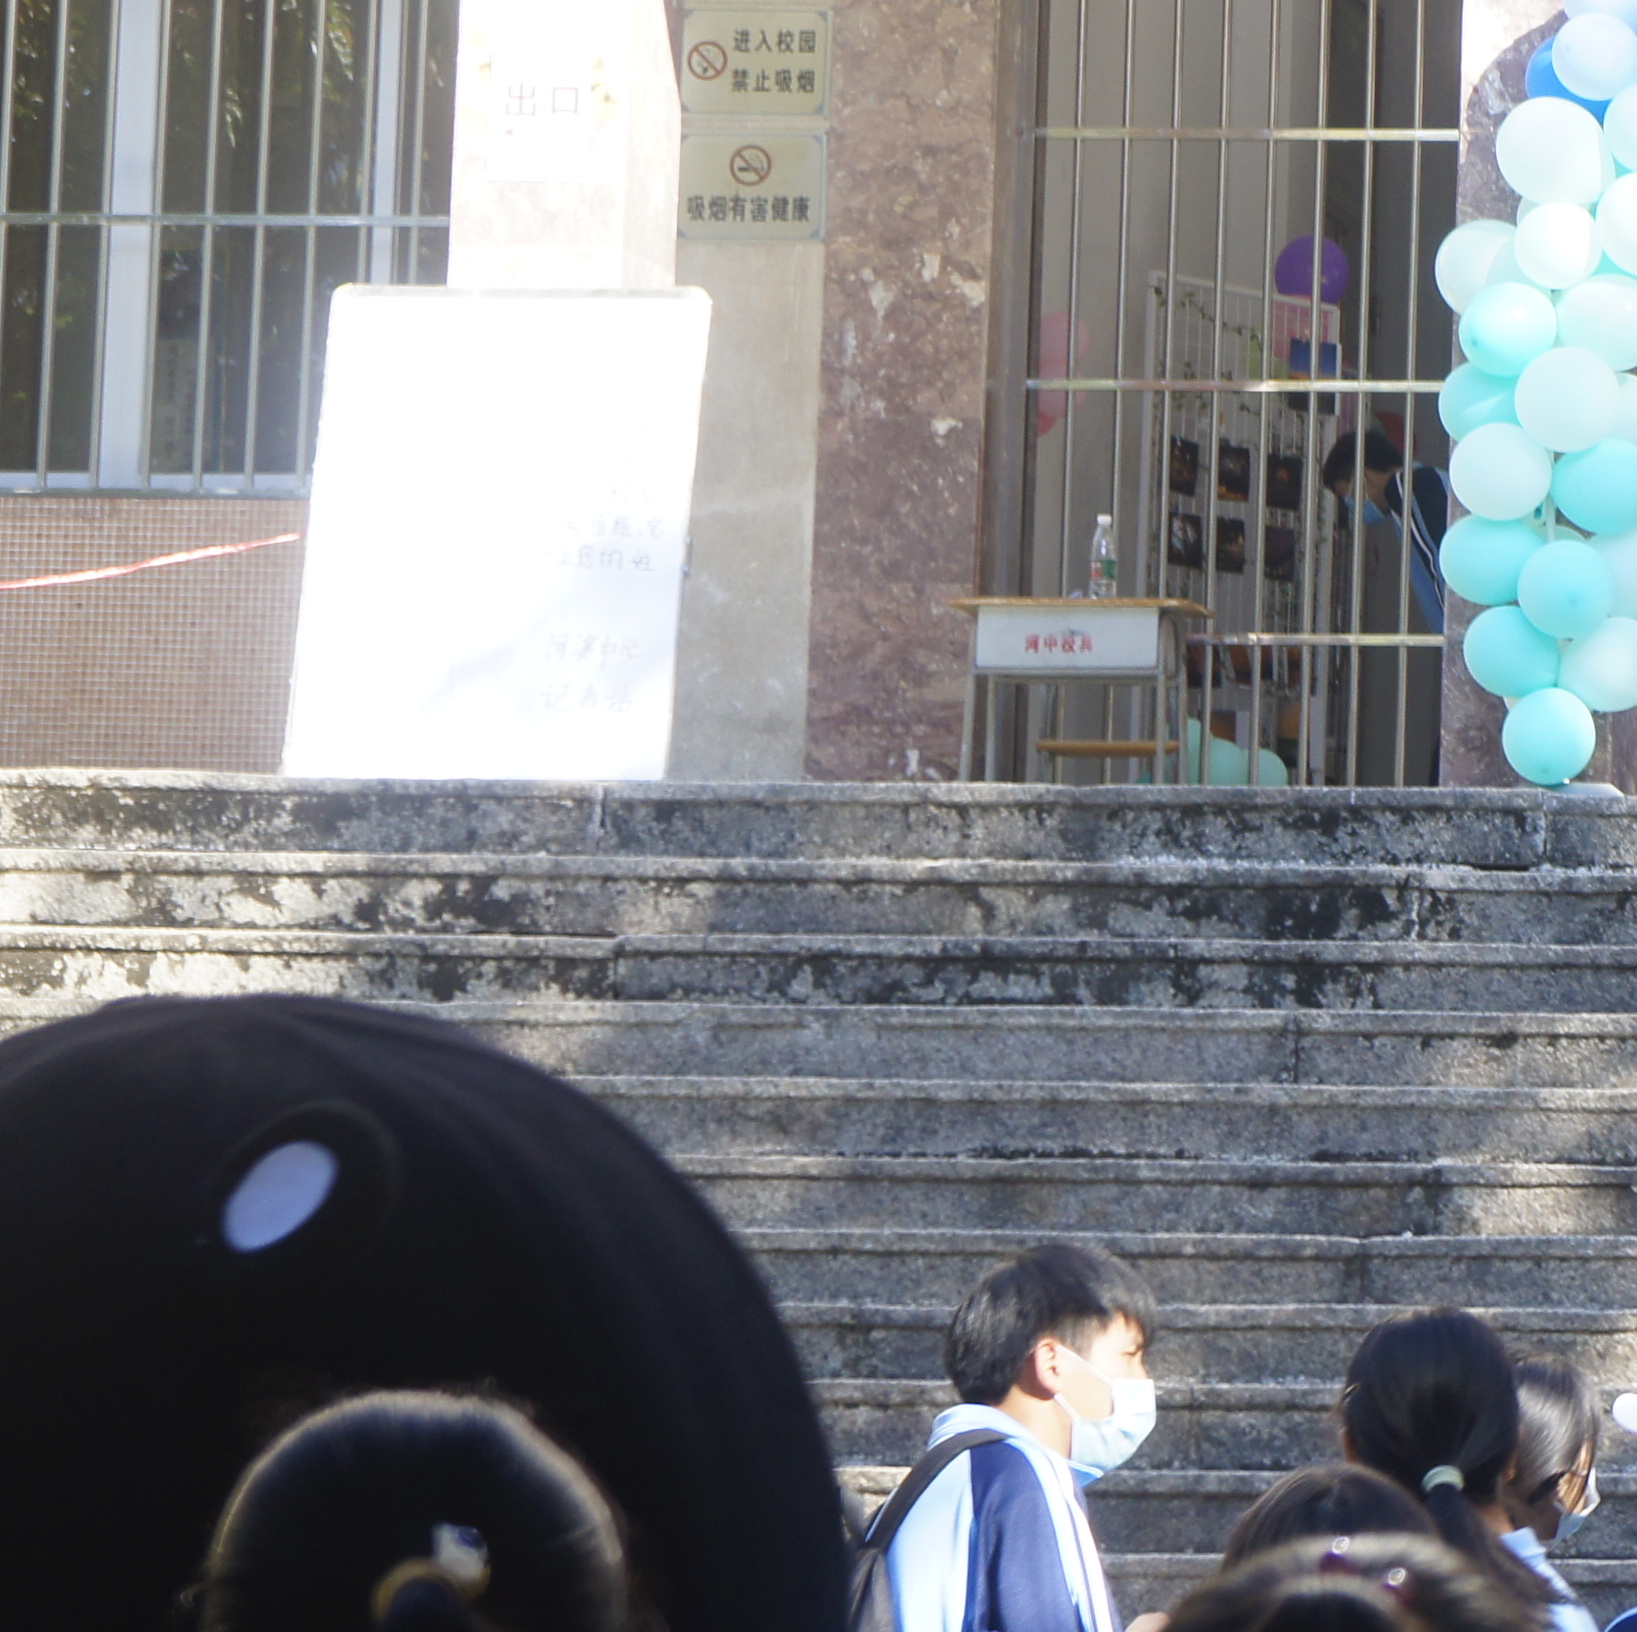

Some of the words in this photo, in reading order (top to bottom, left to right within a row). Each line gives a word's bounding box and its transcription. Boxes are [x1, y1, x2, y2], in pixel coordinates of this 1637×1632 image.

[732, 28, 817, 54] 进入校园
[731, 69, 815, 94] 禁止吸烟
[505, 82, 579, 117] 出口
[687, 194, 811, 223] 吸烟有害健康
